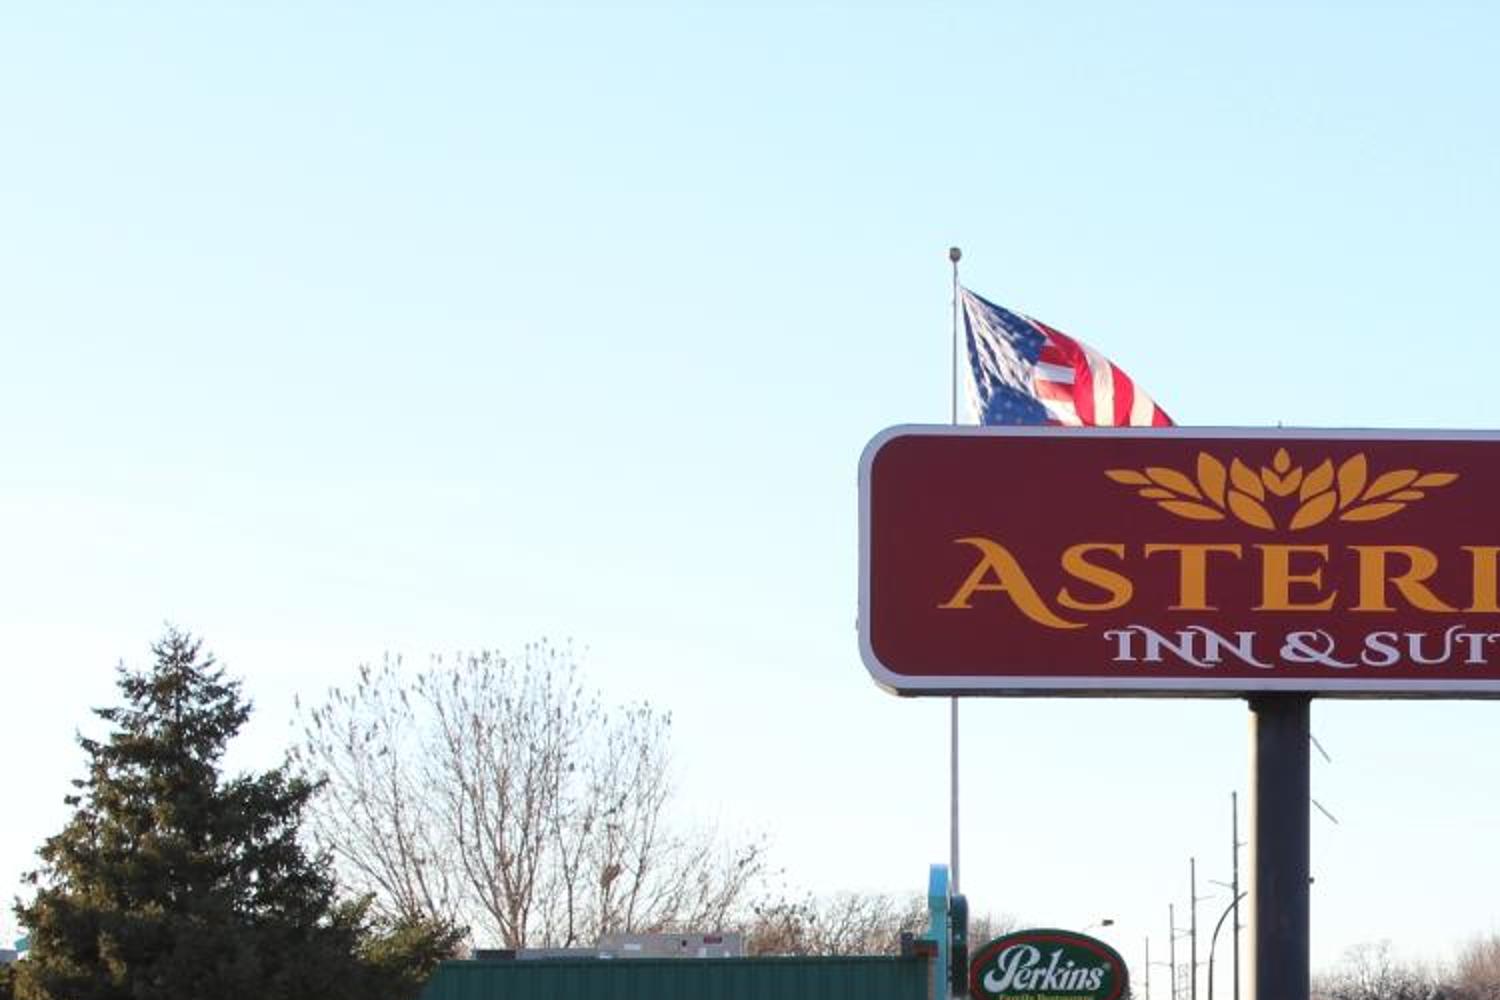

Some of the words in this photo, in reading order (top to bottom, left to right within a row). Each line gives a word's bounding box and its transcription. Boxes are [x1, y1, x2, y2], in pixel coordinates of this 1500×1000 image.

[1103, 624, 1273, 669] INN
[1279, 629, 1358, 668] &
[983, 943, 1105, 993] Perkins
